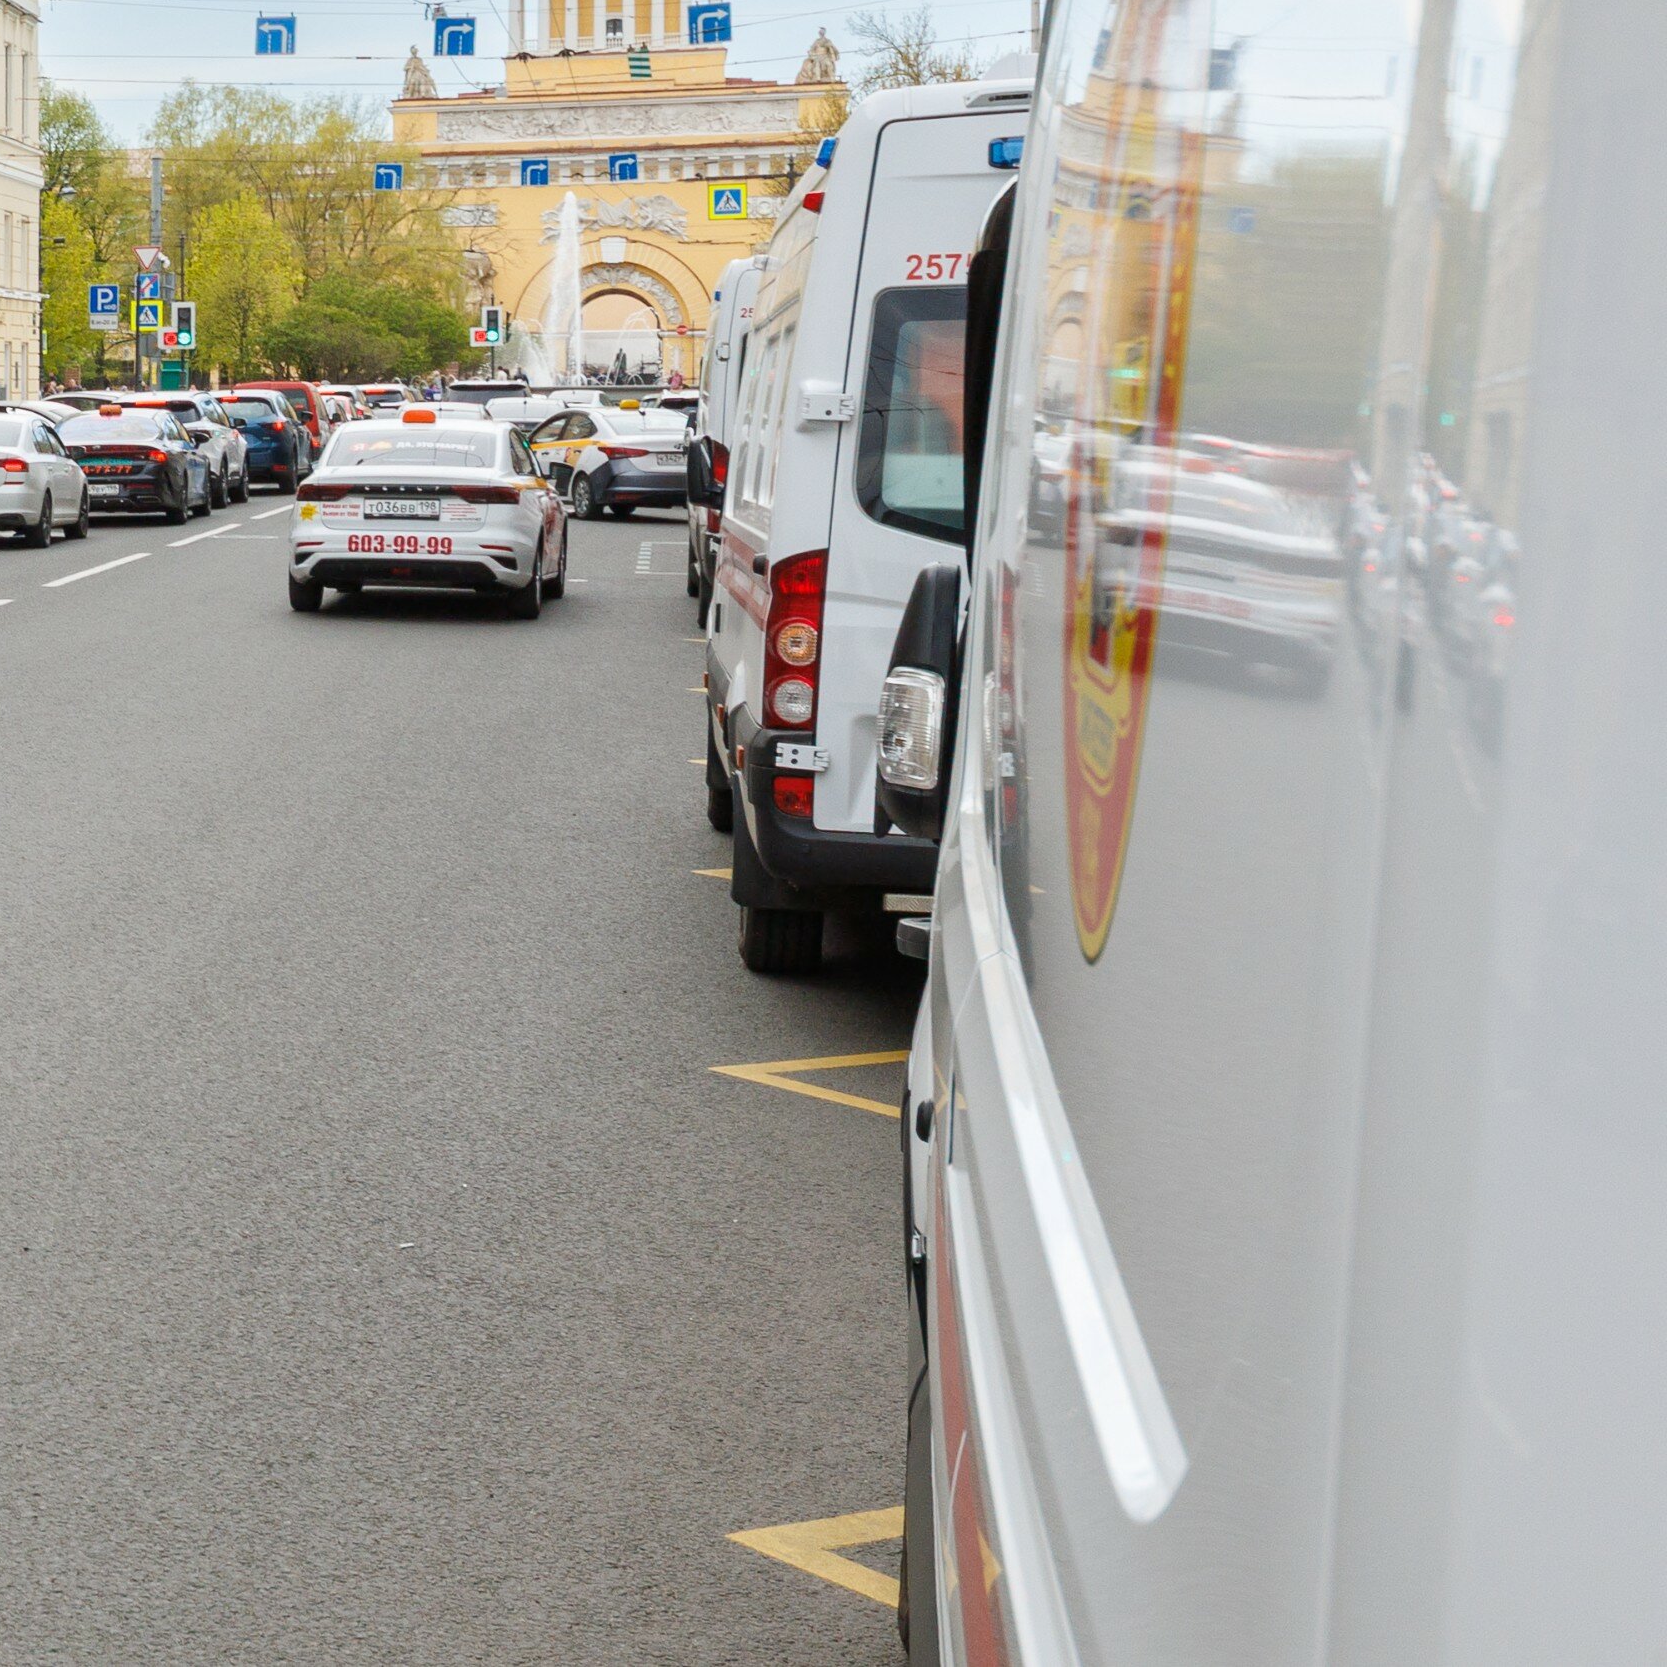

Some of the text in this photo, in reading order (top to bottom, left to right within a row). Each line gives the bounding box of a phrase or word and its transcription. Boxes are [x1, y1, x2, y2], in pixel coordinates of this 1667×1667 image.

[369, 501, 437, 514] Т036ВВ 198
[347, 534, 453, 555] 603-99-99
